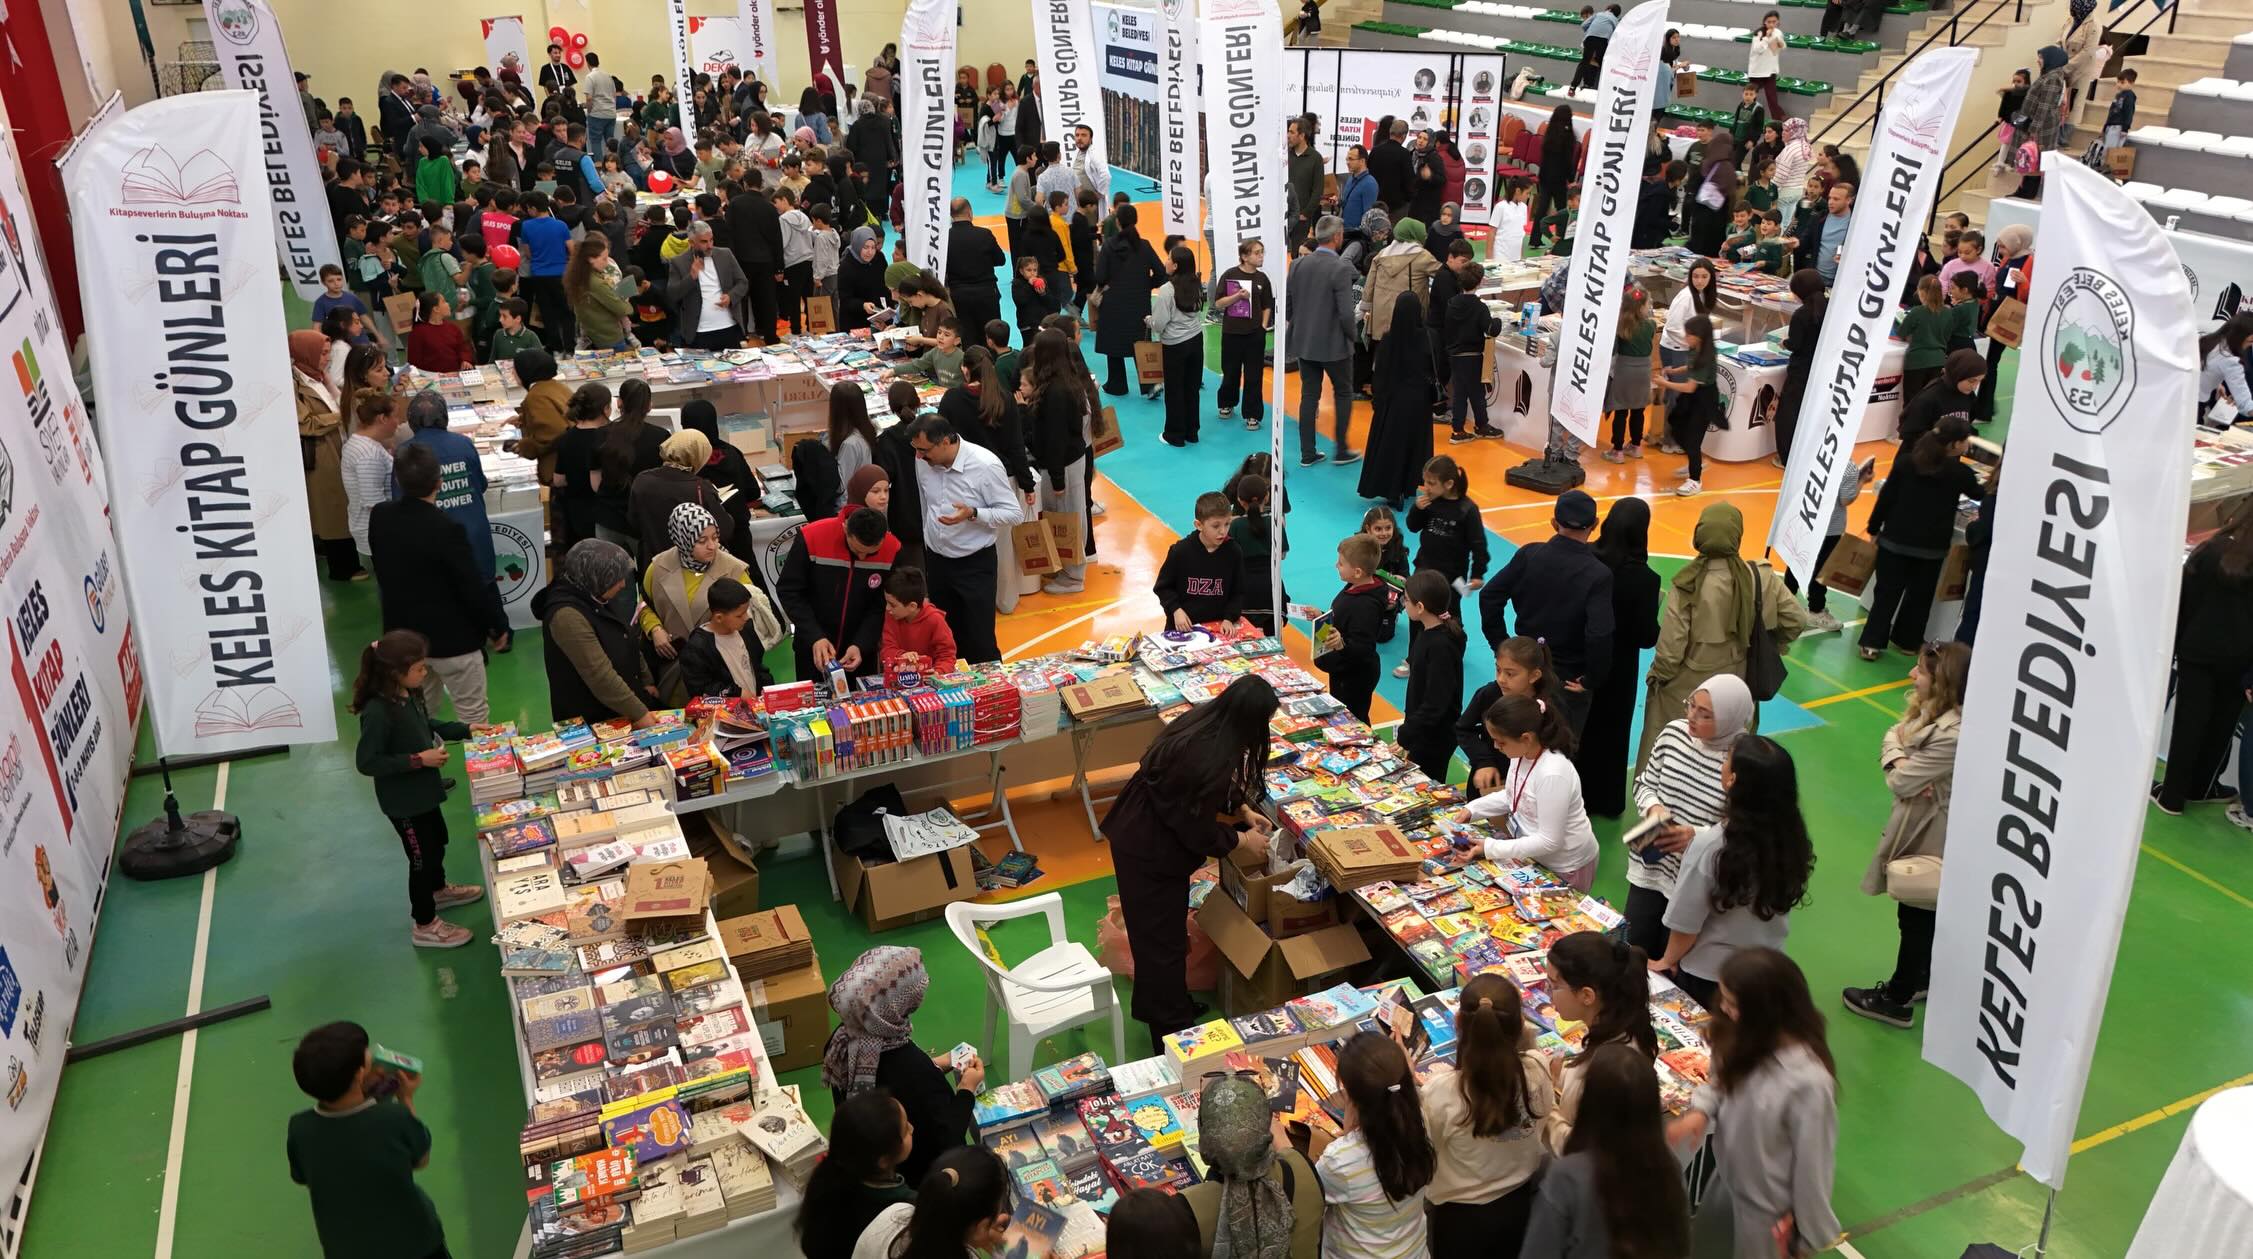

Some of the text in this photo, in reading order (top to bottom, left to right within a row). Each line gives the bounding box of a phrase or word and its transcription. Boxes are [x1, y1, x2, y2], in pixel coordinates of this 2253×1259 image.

[751, 14, 764, 48] yönder
[816, 11, 830, 44] yönder
[1122, 16, 1138, 27] KELES
[1109, 55, 1126, 69] KELES
[1595, 85, 1638, 218] GÜNLERİ
[109, 207, 249, 222] Kitapseverlerin Buluşma Noktası
[1583, 221, 1610, 307] KİTAP
[1571, 308, 1600, 394] KELES
[1800, 426, 1839, 532] KELES
[1829, 322, 1869, 427] KİTAP
[1856, 151, 1924, 322] GÜNLERİ
[136, 233, 276, 688] KELES KİTAP GÜNLERİ
[436, 494, 473, 509] POWER
[441, 478, 469, 492] OUTH
[1186, 576, 1224, 596] DZA
[16, 579, 50, 657] KELES
[32, 638, 65, 715] KİTAP
[1131, 1157, 1161, 1177] ÇOK
